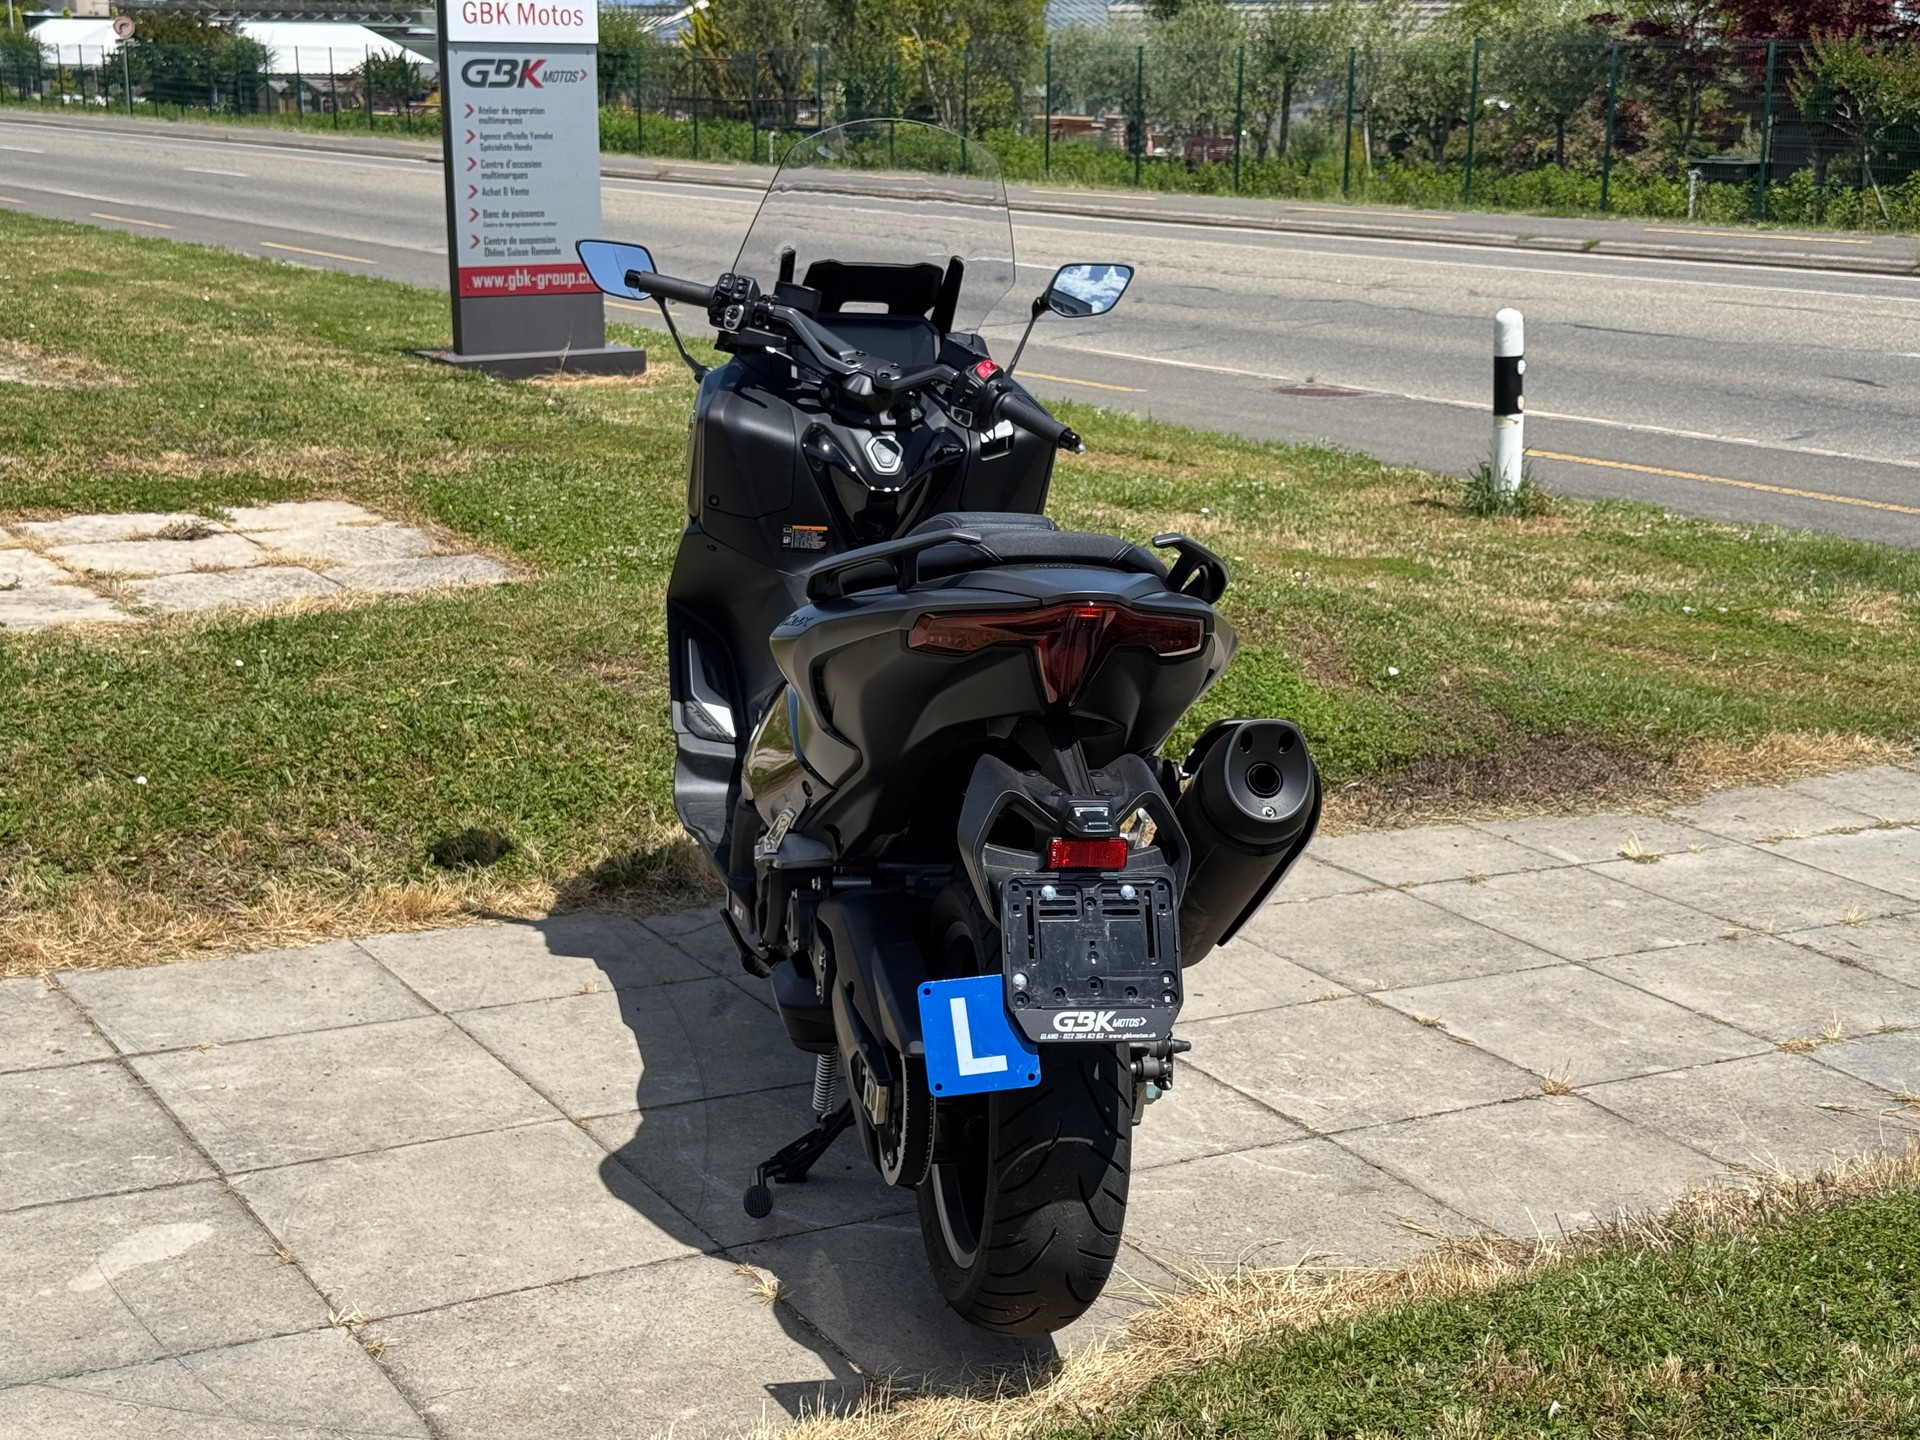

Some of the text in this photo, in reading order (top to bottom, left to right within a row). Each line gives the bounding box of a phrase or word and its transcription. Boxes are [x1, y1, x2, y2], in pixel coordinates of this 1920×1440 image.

[462, 1, 584, 27] GBK Motos
[461, 58, 580, 89] GBK MOTOS
[478, 106, 500, 115] Atelier
[502, 106, 509, 115] de
[478, 116, 523, 126] multimarques
[480, 131, 554, 142] Agence officielle Yamaha
[514, 143, 533, 152] Honda
[481, 159, 543, 169] Centre d'occasion
[481, 170, 529, 181] multimarques
[482, 187, 502, 197] Achat
[510, 187, 530, 196] Vente
[483, 209, 546, 219] Banc de puissance
[484, 236, 557, 246] Centre de suspension
[507, 247, 530, 257] Suisse
[531, 246, 562, 256] Romande
[1052, 1011, 1140, 1032] GBK MOTOS
[949, 997, 1008, 1077] L
